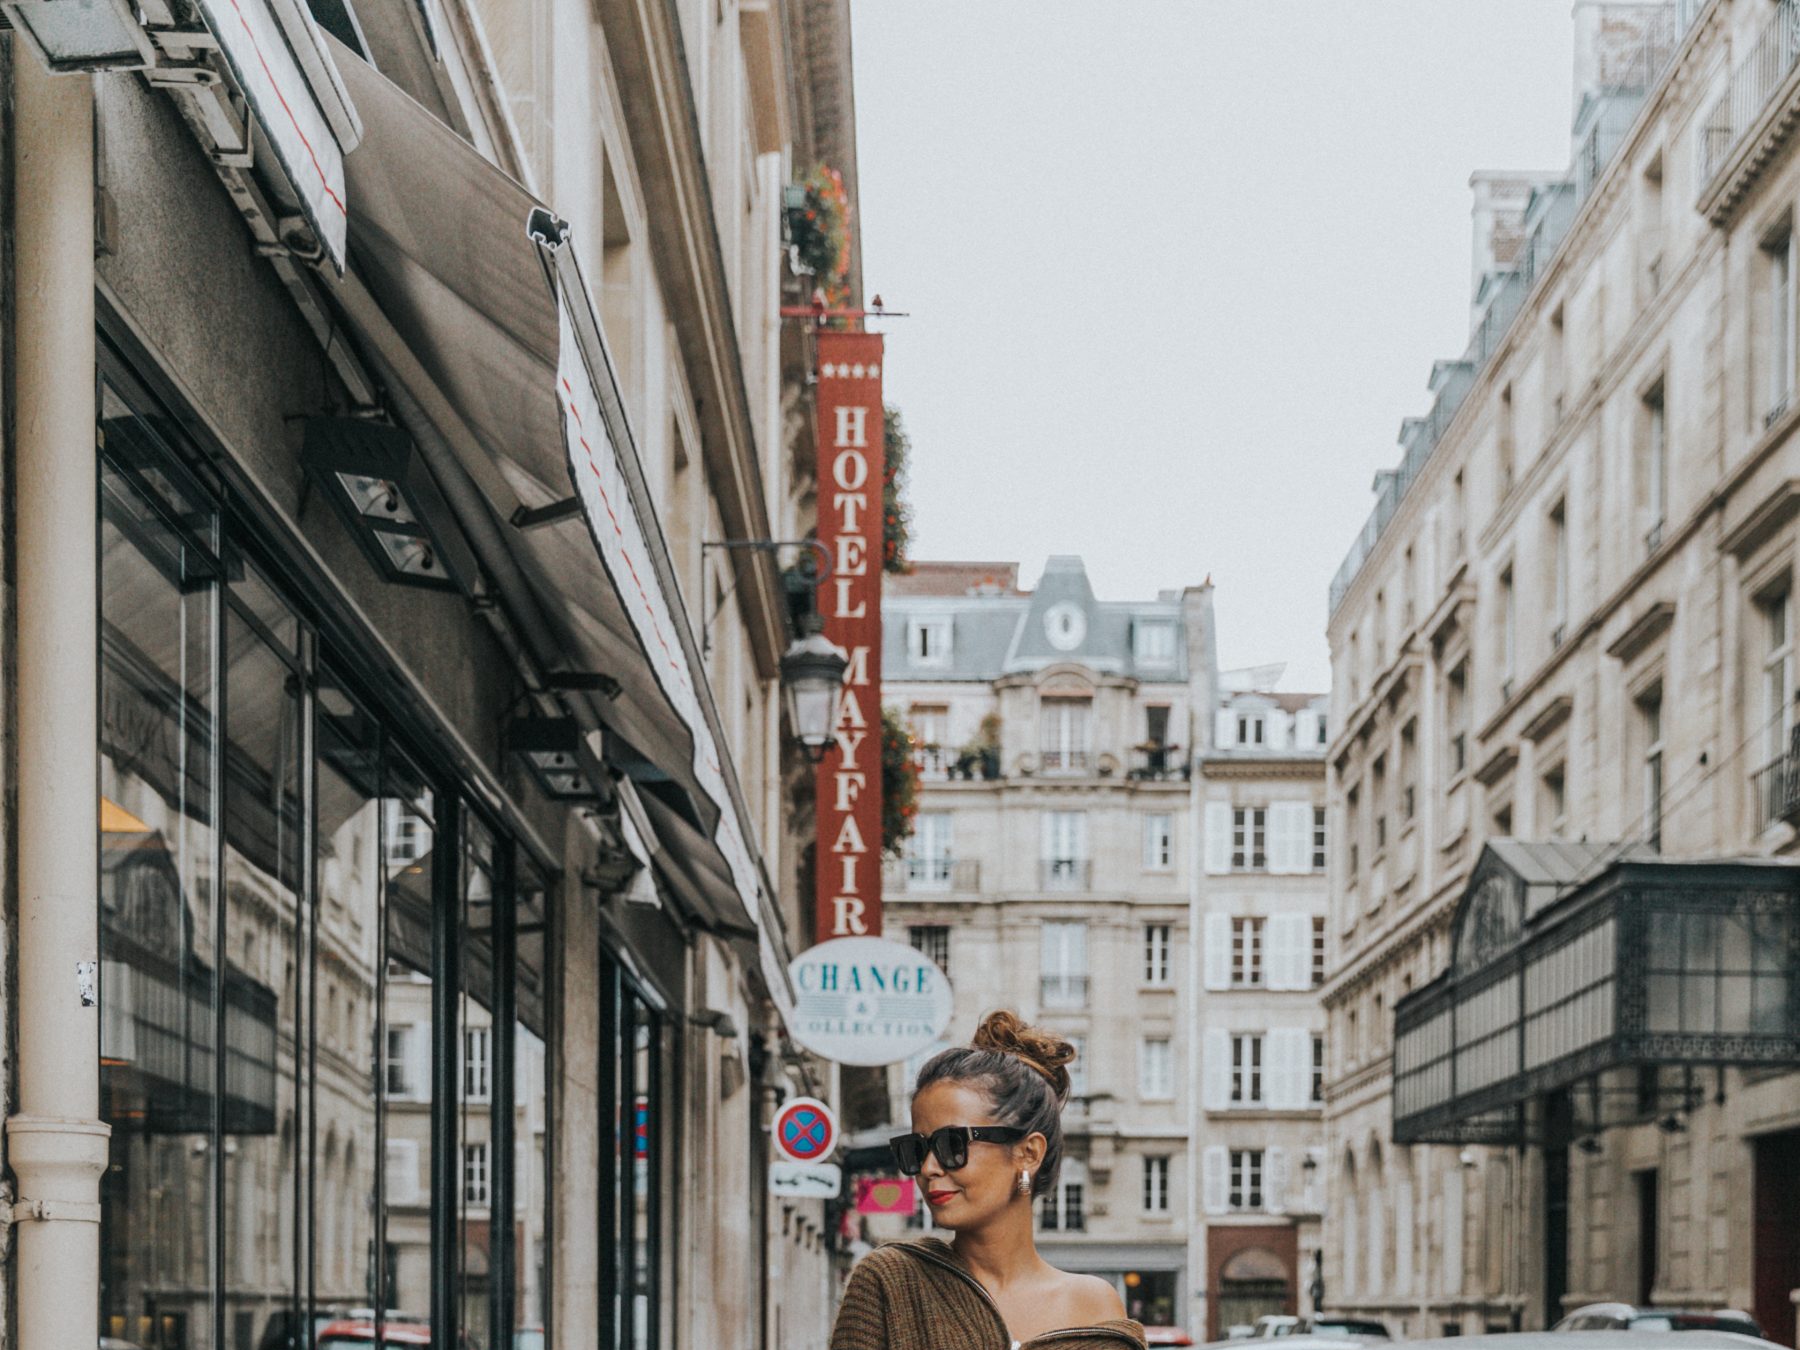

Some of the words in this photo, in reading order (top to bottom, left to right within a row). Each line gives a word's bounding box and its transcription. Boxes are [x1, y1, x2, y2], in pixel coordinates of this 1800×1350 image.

[833, 406, 867, 618] HOTEL
[832, 646, 869, 935] MAYFAIR
[799, 963, 933, 992] CHANGE
